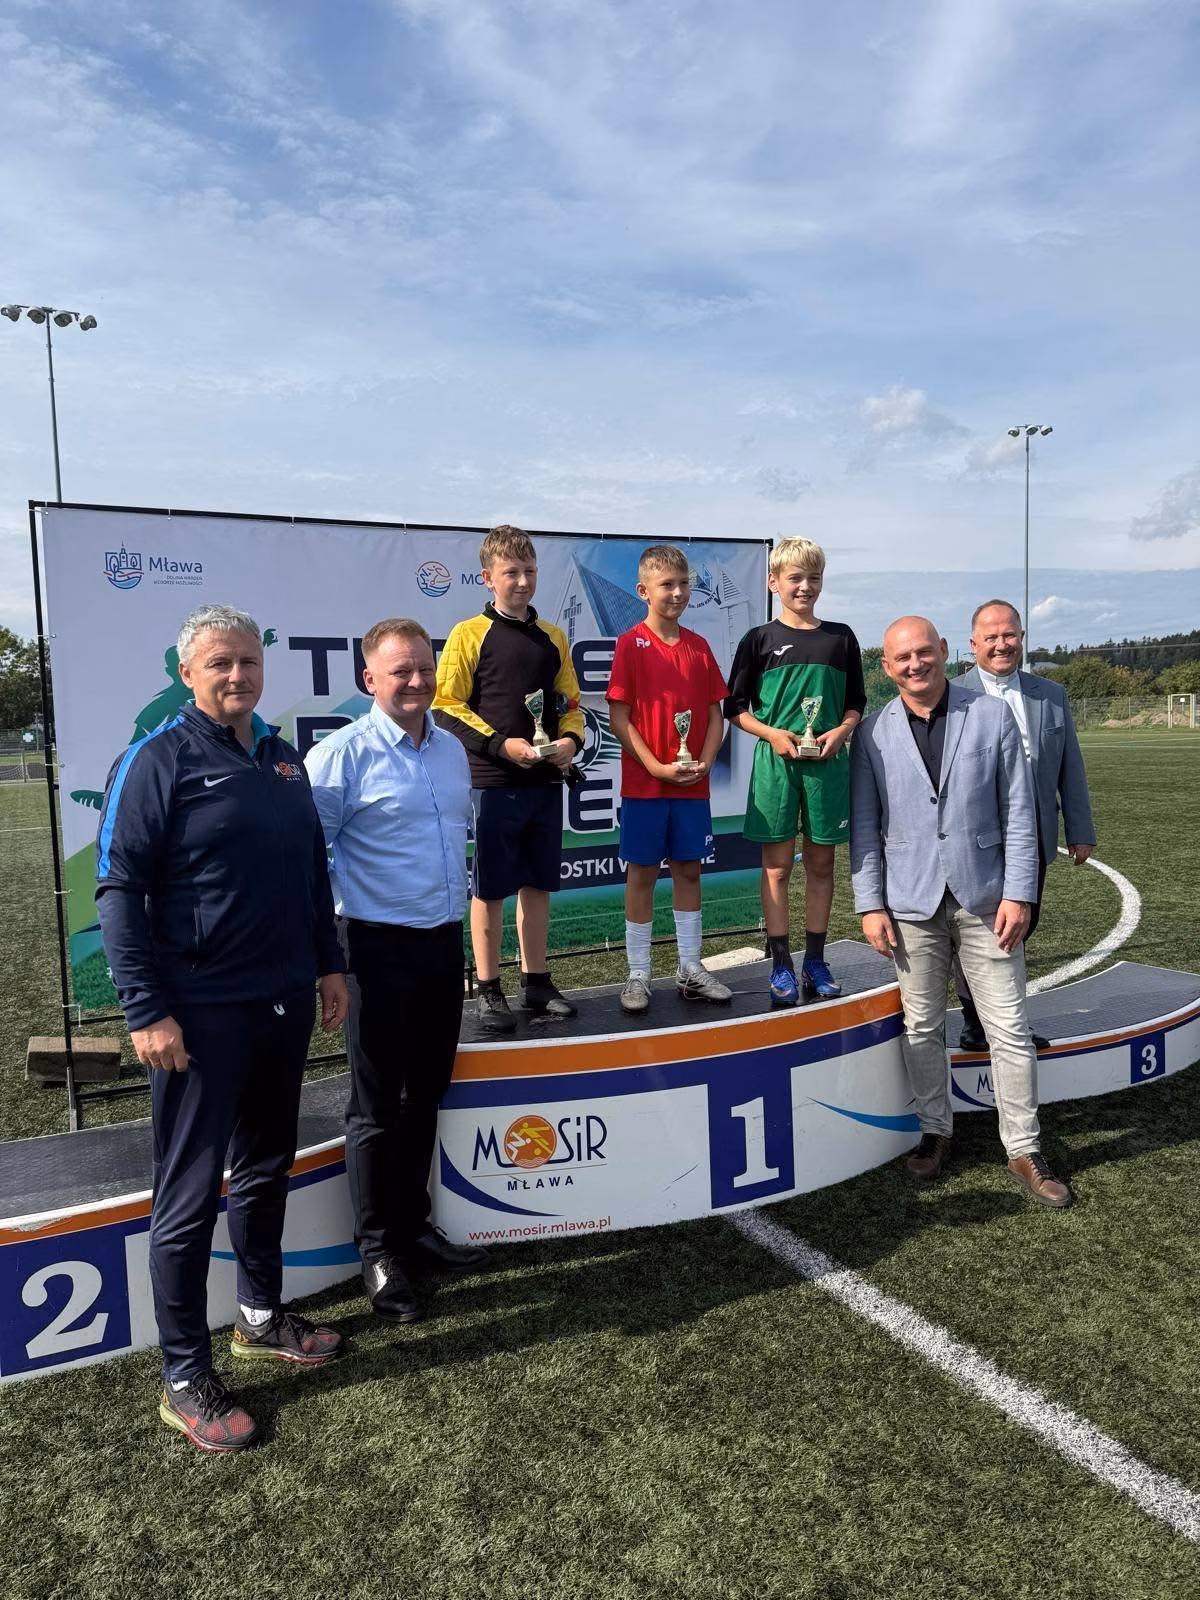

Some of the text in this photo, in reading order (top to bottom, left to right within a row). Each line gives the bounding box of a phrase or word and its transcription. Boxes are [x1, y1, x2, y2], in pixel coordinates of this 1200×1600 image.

[149, 556, 203, 573] Mława
[560, 857, 613, 879] OSTKI
[1141, 1044, 1158, 1075] 3
[730, 1096, 780, 1189] 1
[507, 1175, 575, 1192] MŁAWA
[468, 1215, 612, 1241] www.mosir.mlawa.pl
[21, 1260, 109, 1360] 2
